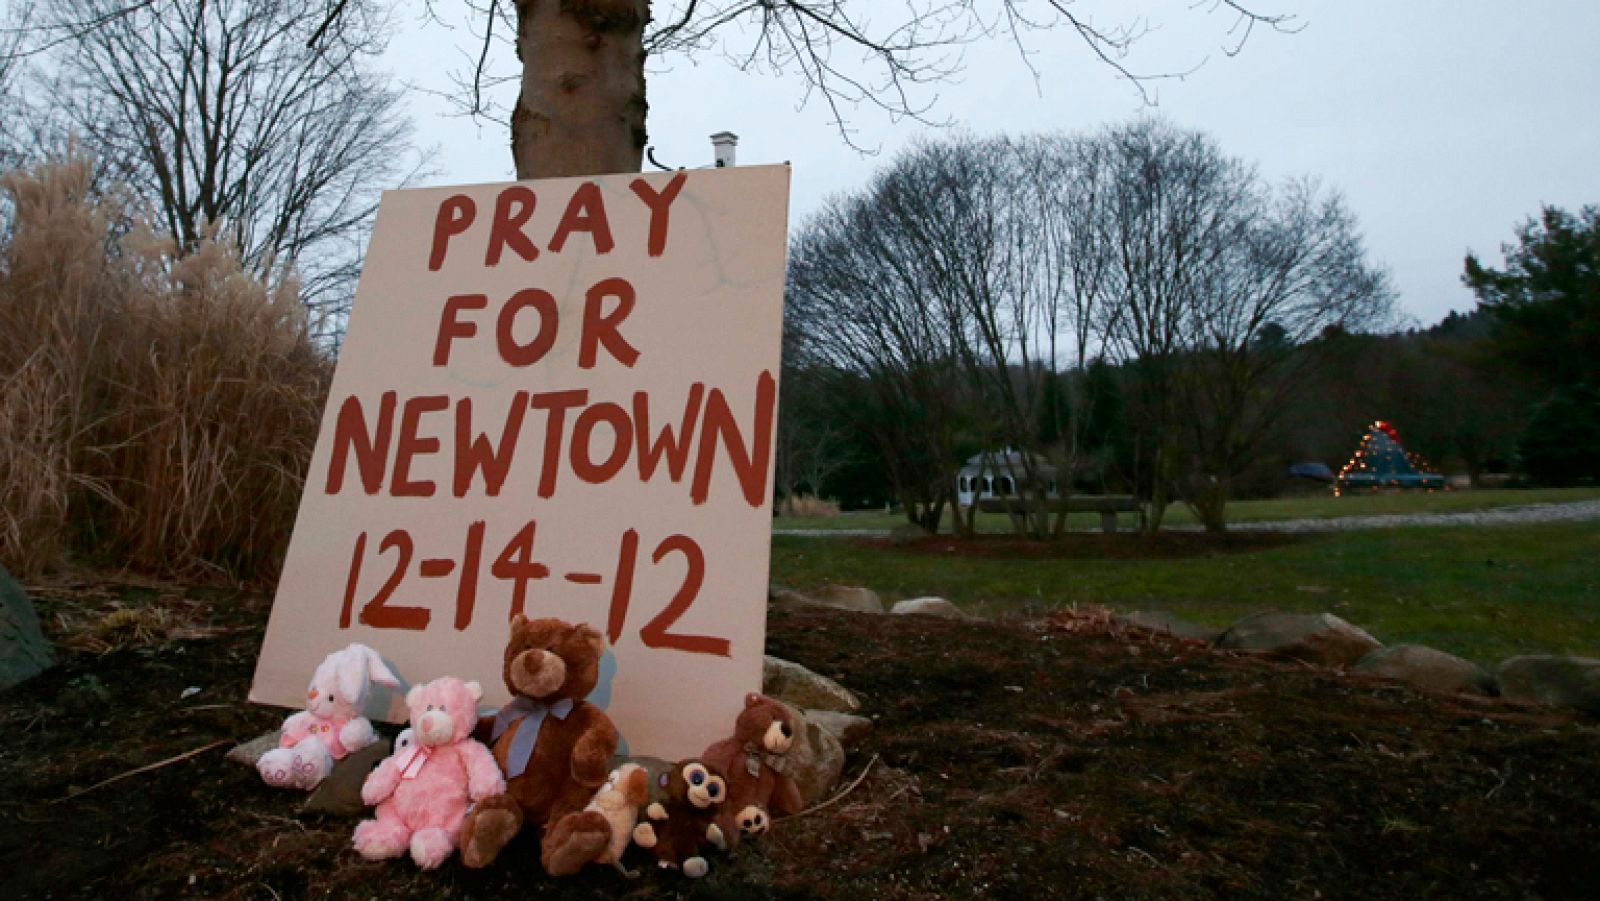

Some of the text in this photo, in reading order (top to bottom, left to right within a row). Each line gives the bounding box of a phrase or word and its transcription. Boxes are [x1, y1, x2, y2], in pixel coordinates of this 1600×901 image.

[429, 173, 686, 271] PRAY
[433, 278, 640, 369] FOR
[325, 370, 776, 507] NEWTOWN
[339, 520, 731, 656] 12-14-12
